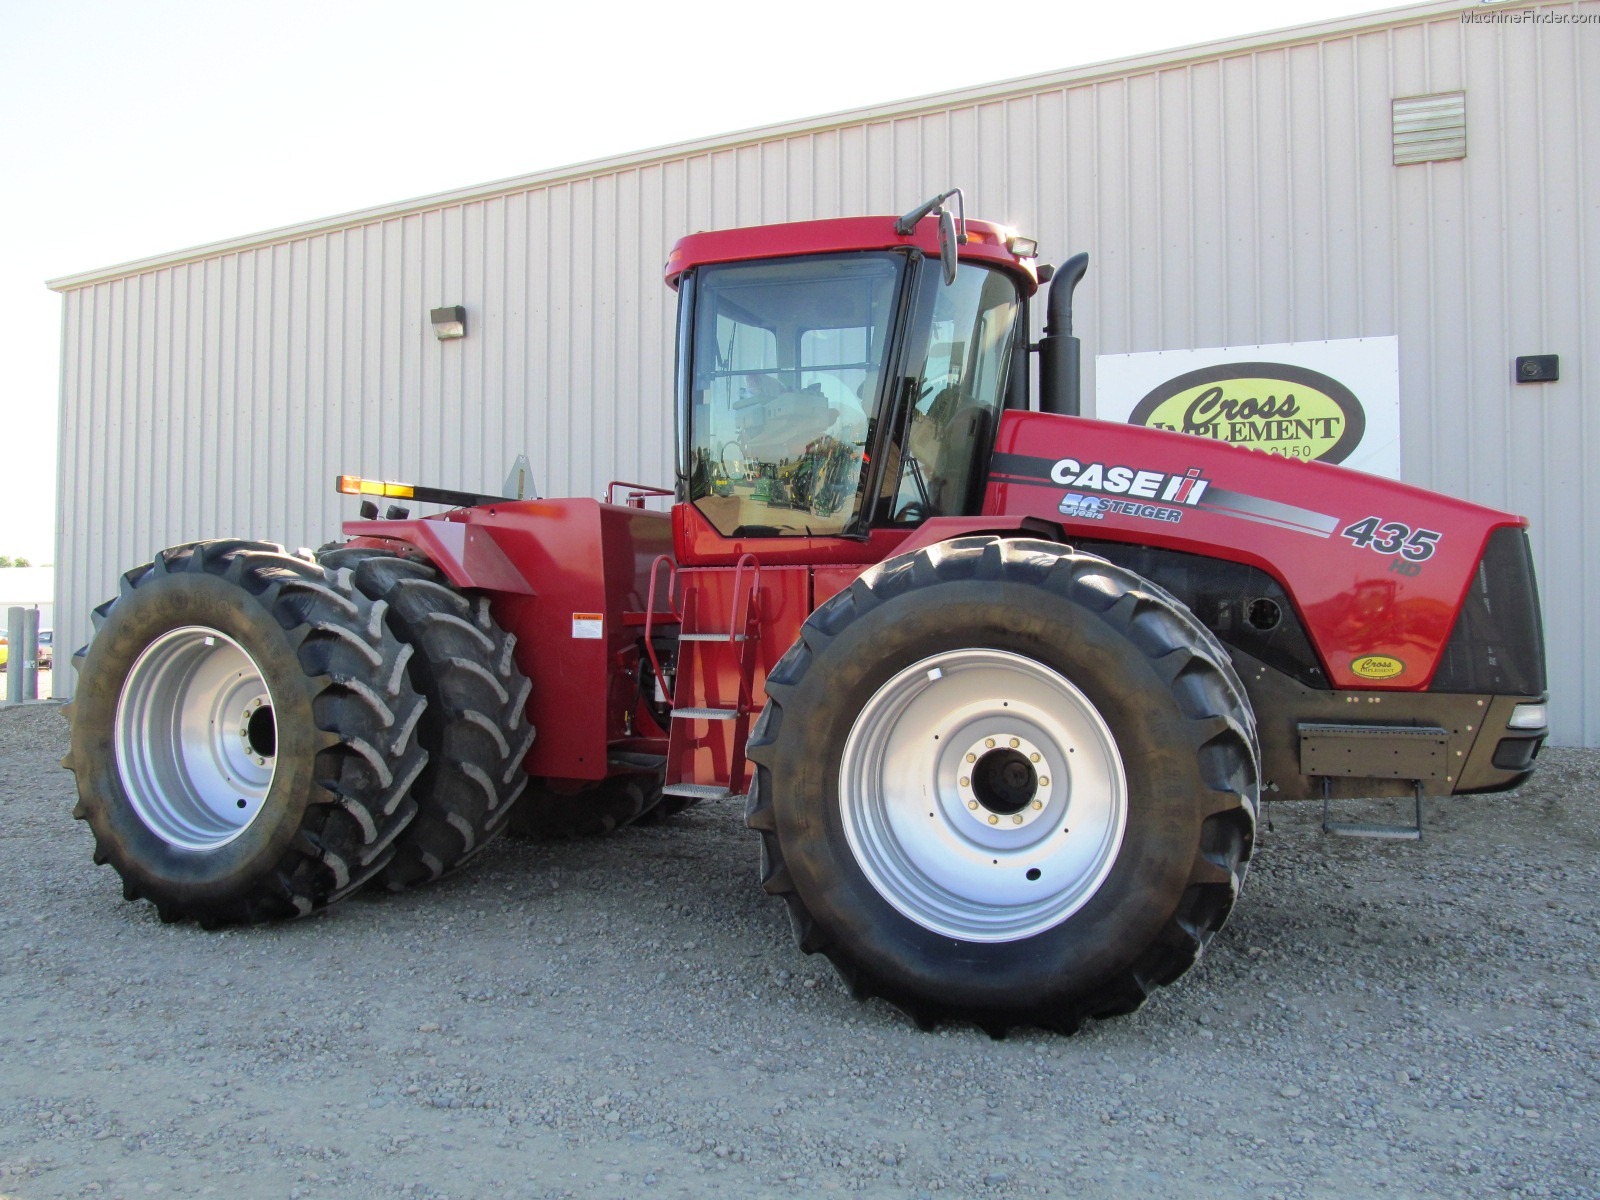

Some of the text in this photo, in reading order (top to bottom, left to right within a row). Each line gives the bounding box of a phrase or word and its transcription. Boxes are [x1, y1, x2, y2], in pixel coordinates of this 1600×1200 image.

[1183, 386, 1300, 430] Cross
[1153, 417, 1340, 442] PLEMENT
[1050, 458, 1165, 498] CASE
[1072, 508, 1104, 520] years
[1098, 498, 1182, 523] STEIGER
[1340, 515, 1442, 562] 435
[1387, 559, 1422, 577] HD
[1361, 658, 1392, 669] Cross
